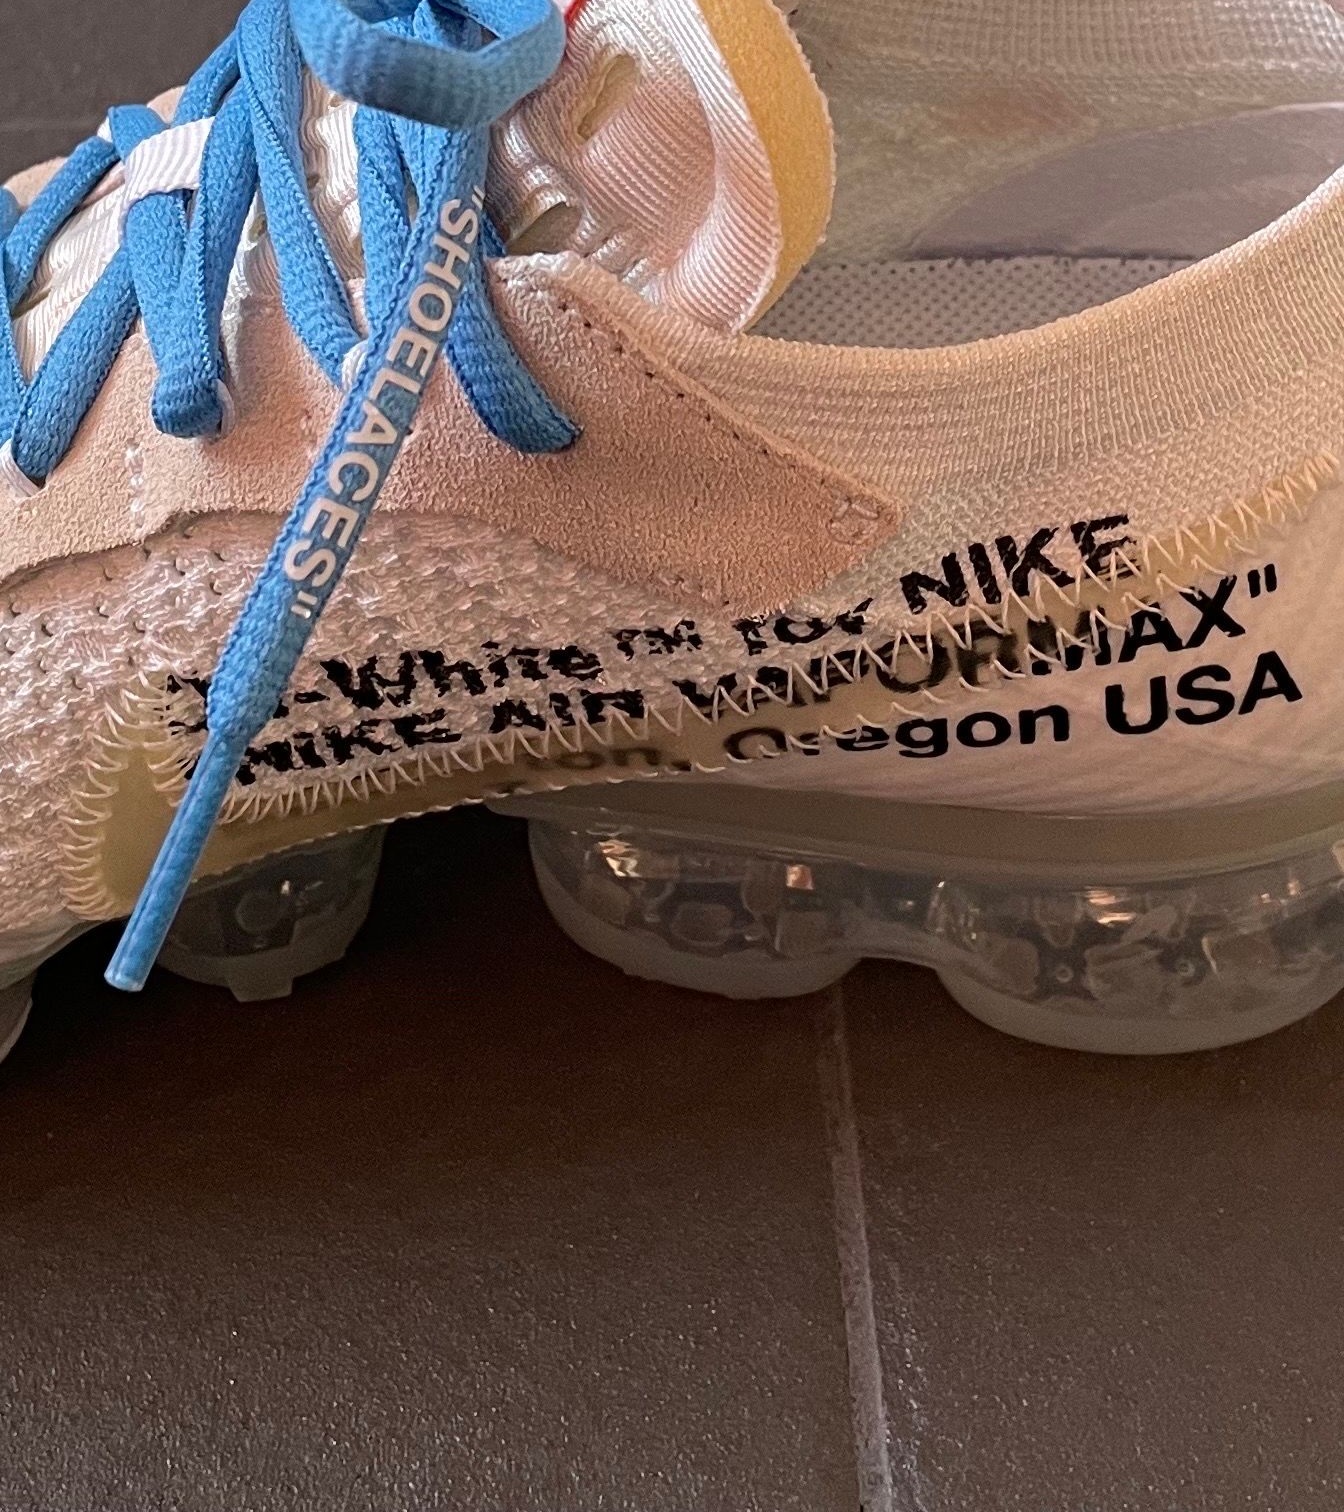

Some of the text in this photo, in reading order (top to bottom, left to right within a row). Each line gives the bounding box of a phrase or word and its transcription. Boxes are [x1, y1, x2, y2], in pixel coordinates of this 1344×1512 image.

[282, 185, 486, 621] "SHOELACES"
[898, 513, 1139, 616] NIKE
[489, 689, 646, 734] AIR
[1104, 650, 1304, 736] USA
